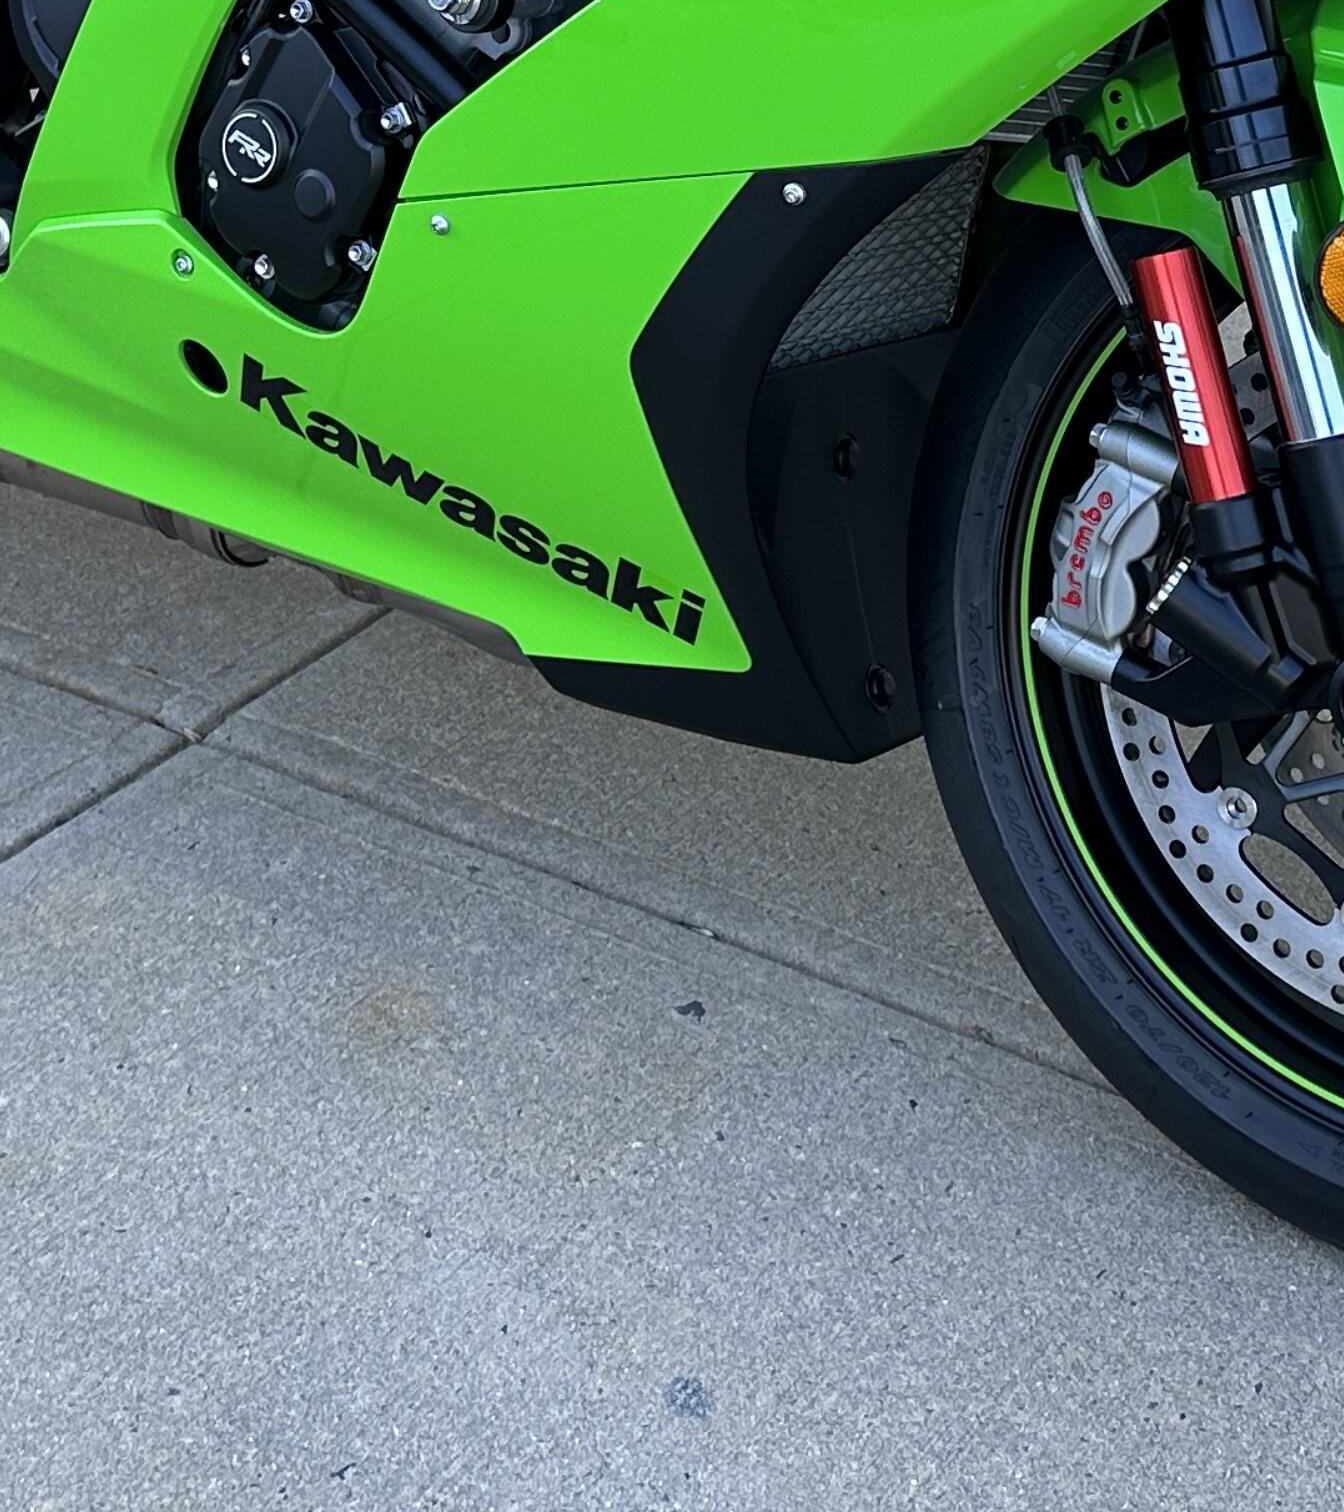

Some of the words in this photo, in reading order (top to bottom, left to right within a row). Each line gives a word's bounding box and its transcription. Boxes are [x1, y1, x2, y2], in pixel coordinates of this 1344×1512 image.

[1153, 320, 1210, 447] SHOWA
[240, 353, 706, 646] Kawasaki
[1061, 491, 1114, 610] brembo
